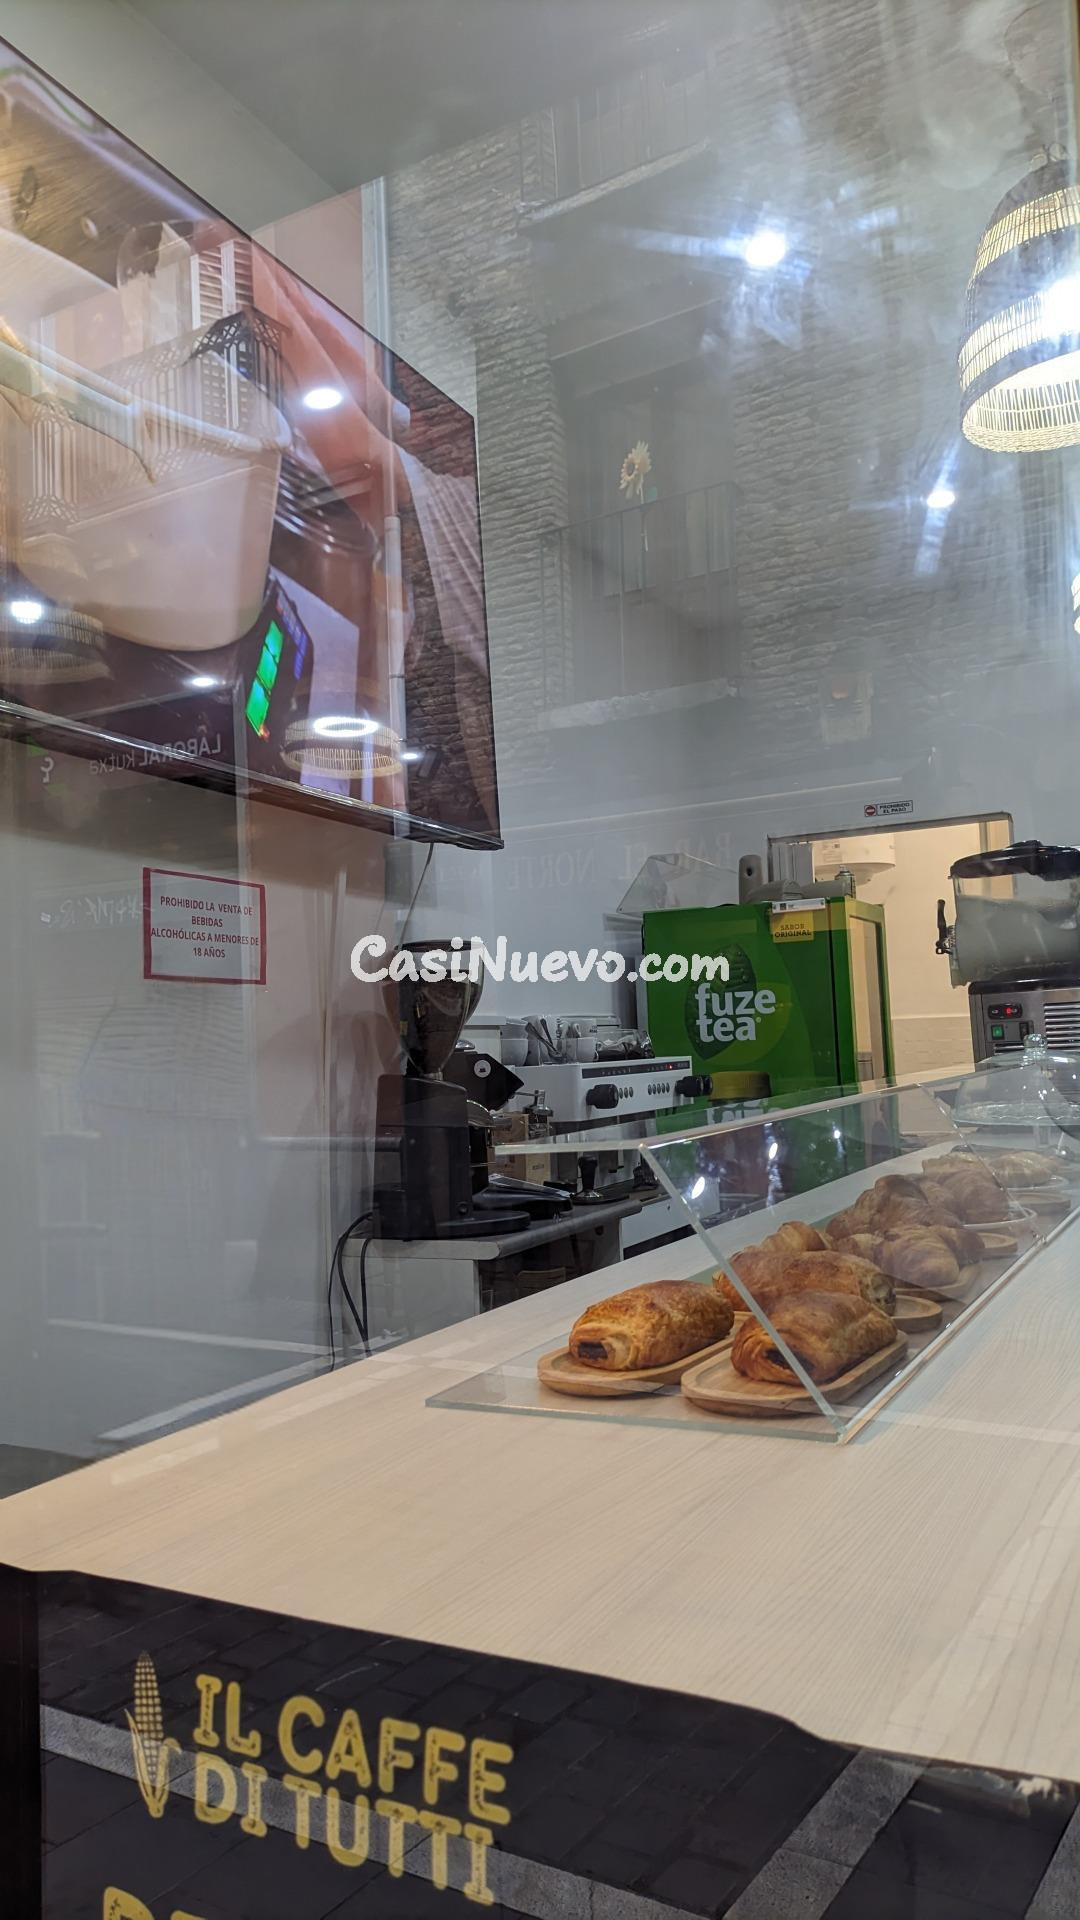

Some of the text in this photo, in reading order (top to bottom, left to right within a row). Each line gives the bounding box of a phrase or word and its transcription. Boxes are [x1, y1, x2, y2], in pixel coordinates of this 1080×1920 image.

[160, 896, 253, 916] PROHIBIDO LA VENTA DE
[191, 916, 223, 928] BEBIDAS
[151, 927, 259, 946] ALCOHÓLICAS A MENORES DE
[774, 929, 812, 938] ORIGINAL
[193, 946, 226, 958] 18 AÑOS
[695, 982, 776, 1016] fuze
[696, 1011, 757, 1042] tea
[193, 1674, 514, 1825] IL CAFFE
[194, 1752, 494, 1906] DI TUTTI
